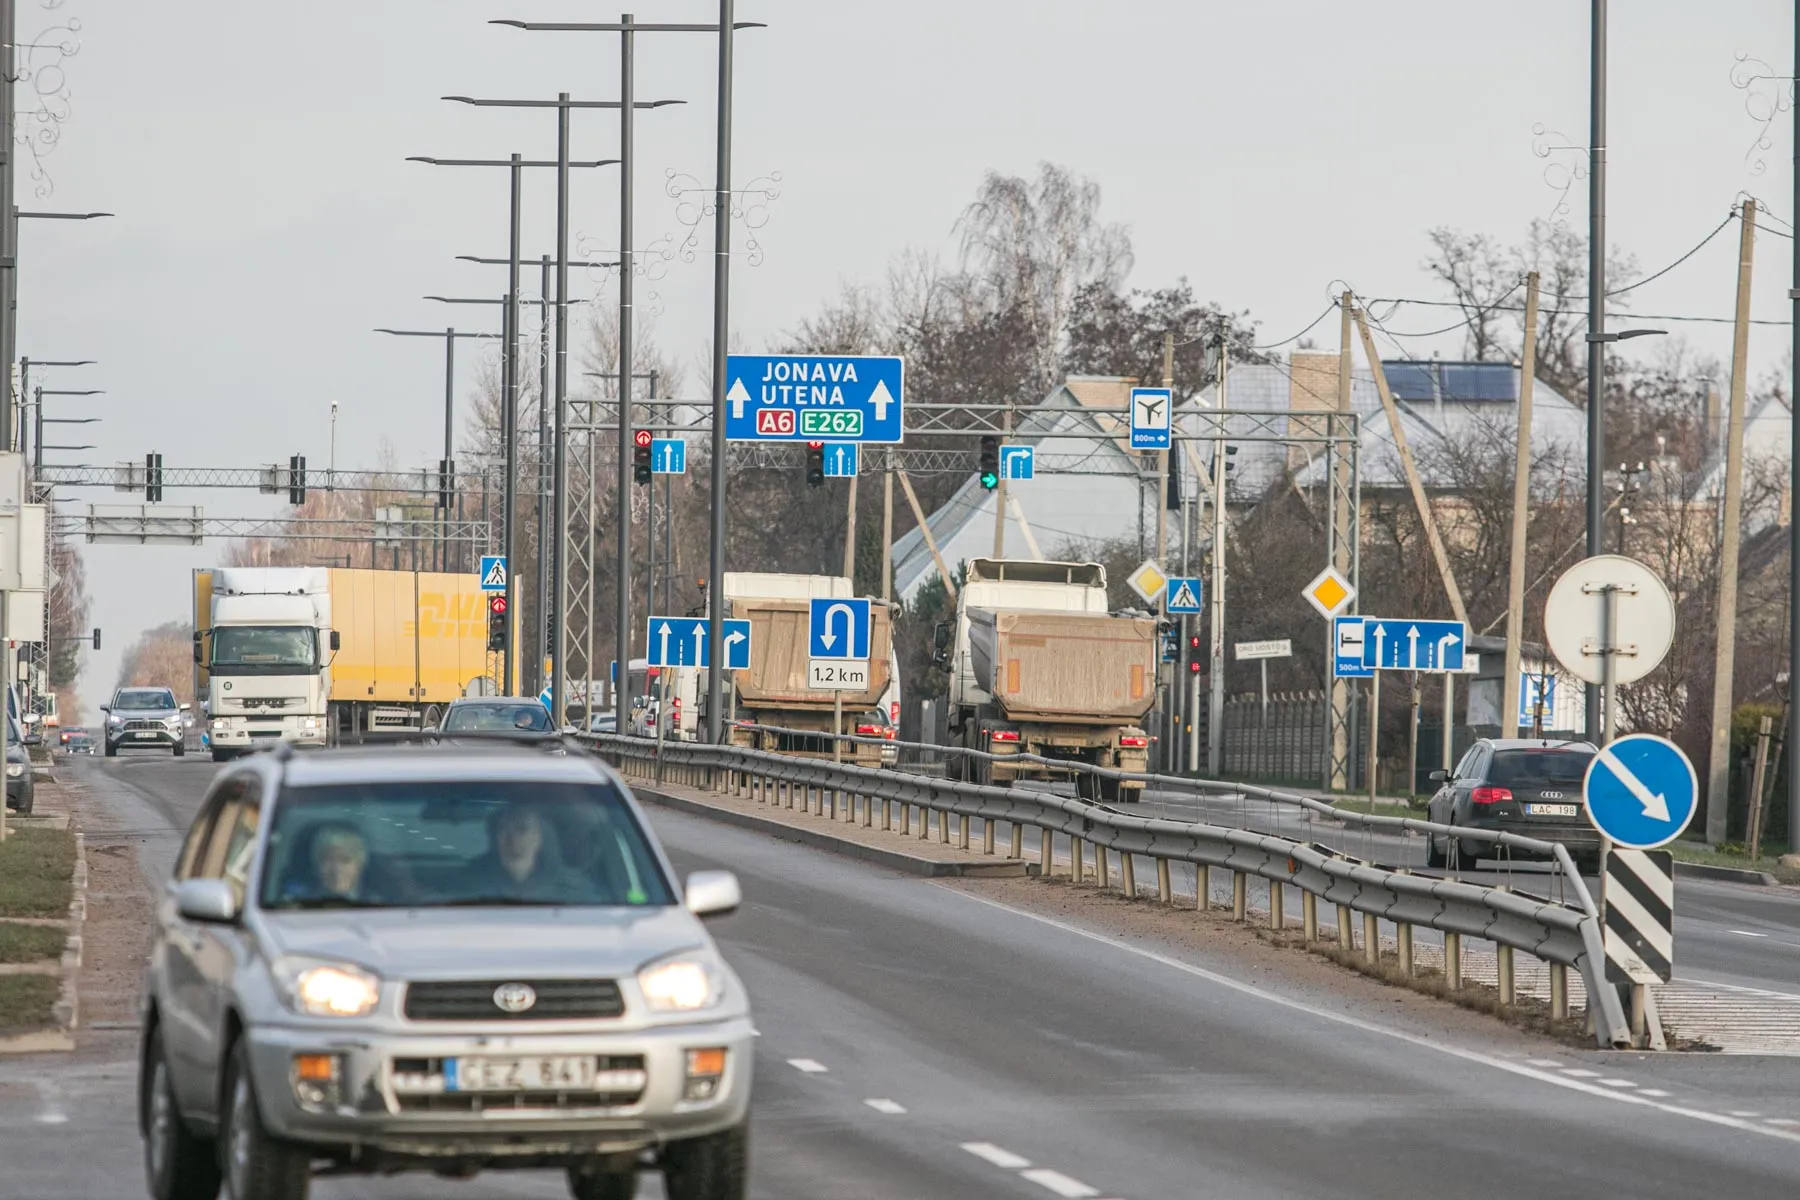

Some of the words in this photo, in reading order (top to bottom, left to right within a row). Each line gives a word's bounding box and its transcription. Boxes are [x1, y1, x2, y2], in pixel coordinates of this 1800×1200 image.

[762, 362, 858, 382] JONAVA
[762, 385, 844, 405] UTENA
[761, 412, 791, 431] A6
[804, 413, 858, 432] E262
[1134, 434, 1155, 442] 800m
[839, 668, 863, 682] km
[1531, 805, 1552, 814] LAC
[1559, 806, 1575, 815] 198
[462, 1062, 524, 1089] CEZ
